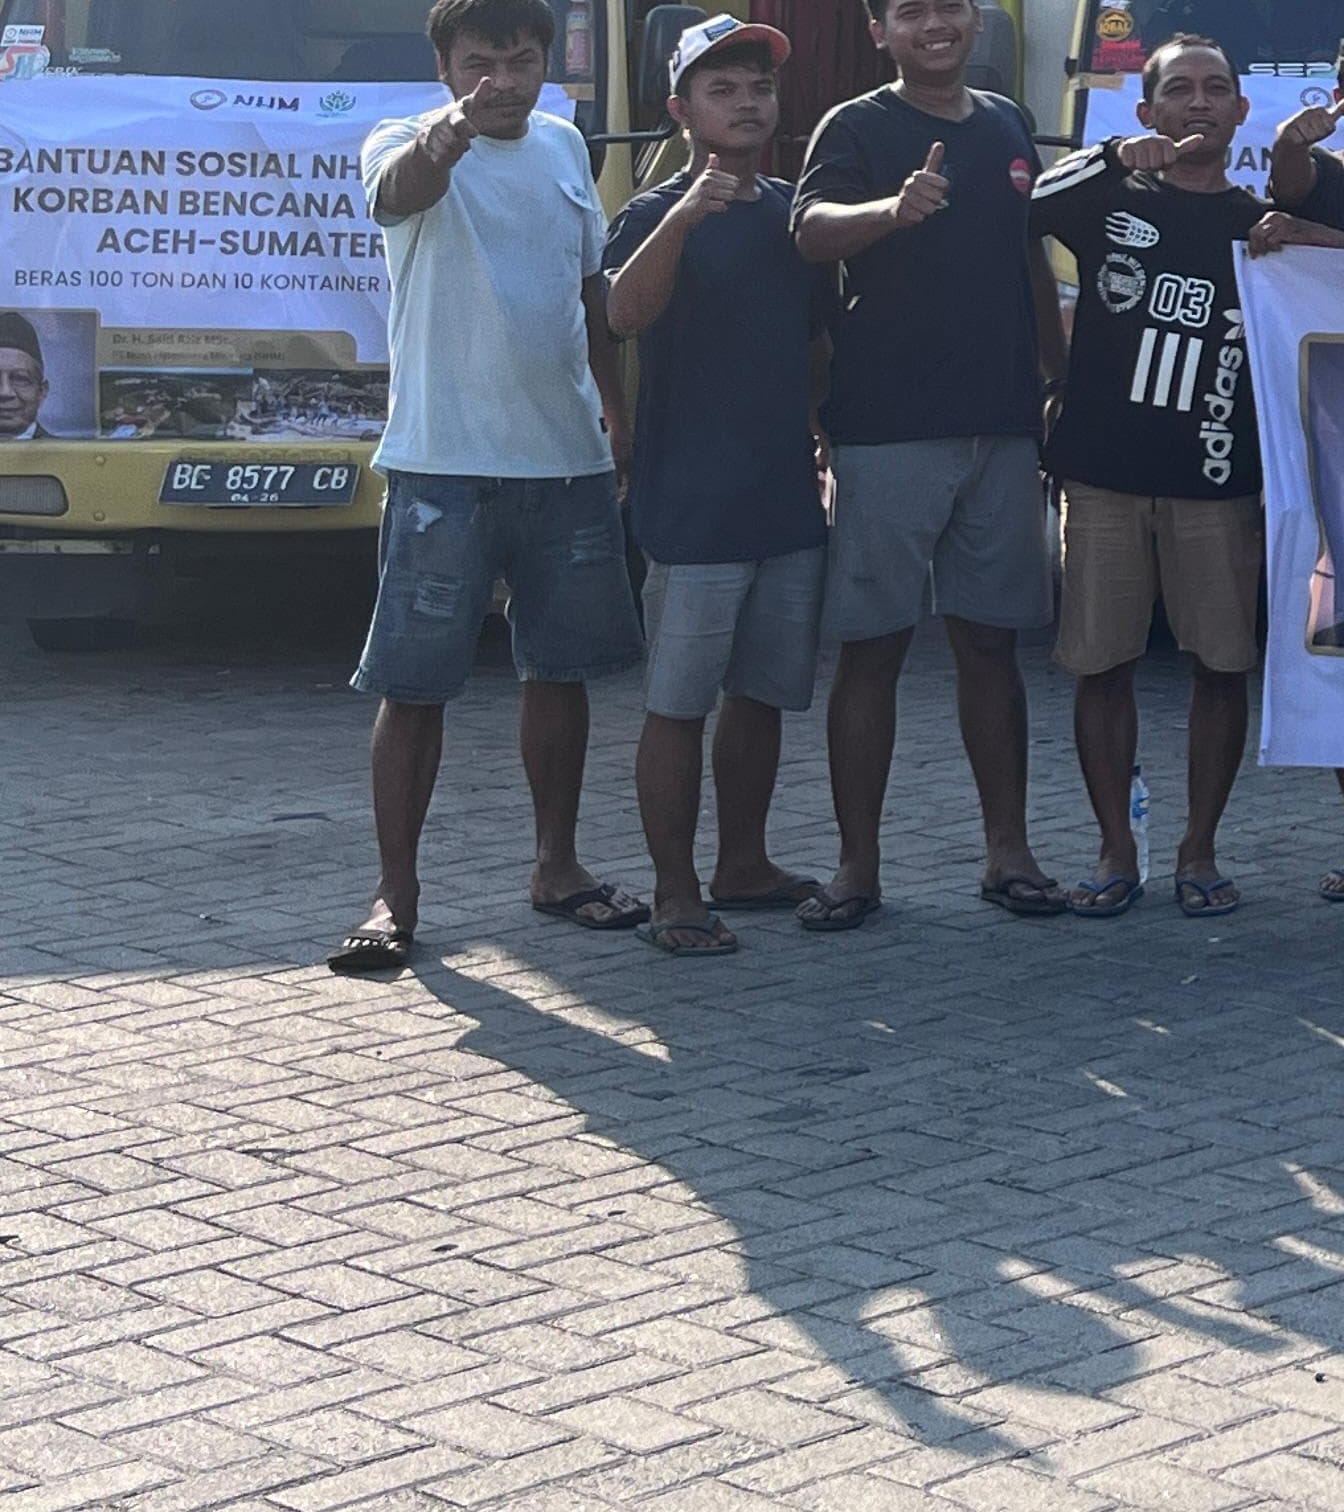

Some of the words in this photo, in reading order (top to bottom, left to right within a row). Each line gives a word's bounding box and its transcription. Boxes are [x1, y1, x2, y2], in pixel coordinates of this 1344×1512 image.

[175, 152, 302, 180] SOSIAL
[311, 153, 363, 181] NH
[13, 186, 169, 215] KORBAN
[178, 189, 356, 219] BENCANA
[96, 227, 386, 258] ACEH-SUMATER
[14, 269, 81, 288] BERAS
[89, 270, 123, 288] 100
[130, 272, 175, 289] TON
[181, 272, 226, 290] DAN
[233, 273, 252, 290] 10
[260, 274, 380, 292] KONTAINER
[1148, 273, 1216, 328] 03
[1199, 345, 1244, 485] adidas
[226, 465, 295, 490] 8577
[312, 467, 350, 490] CB
